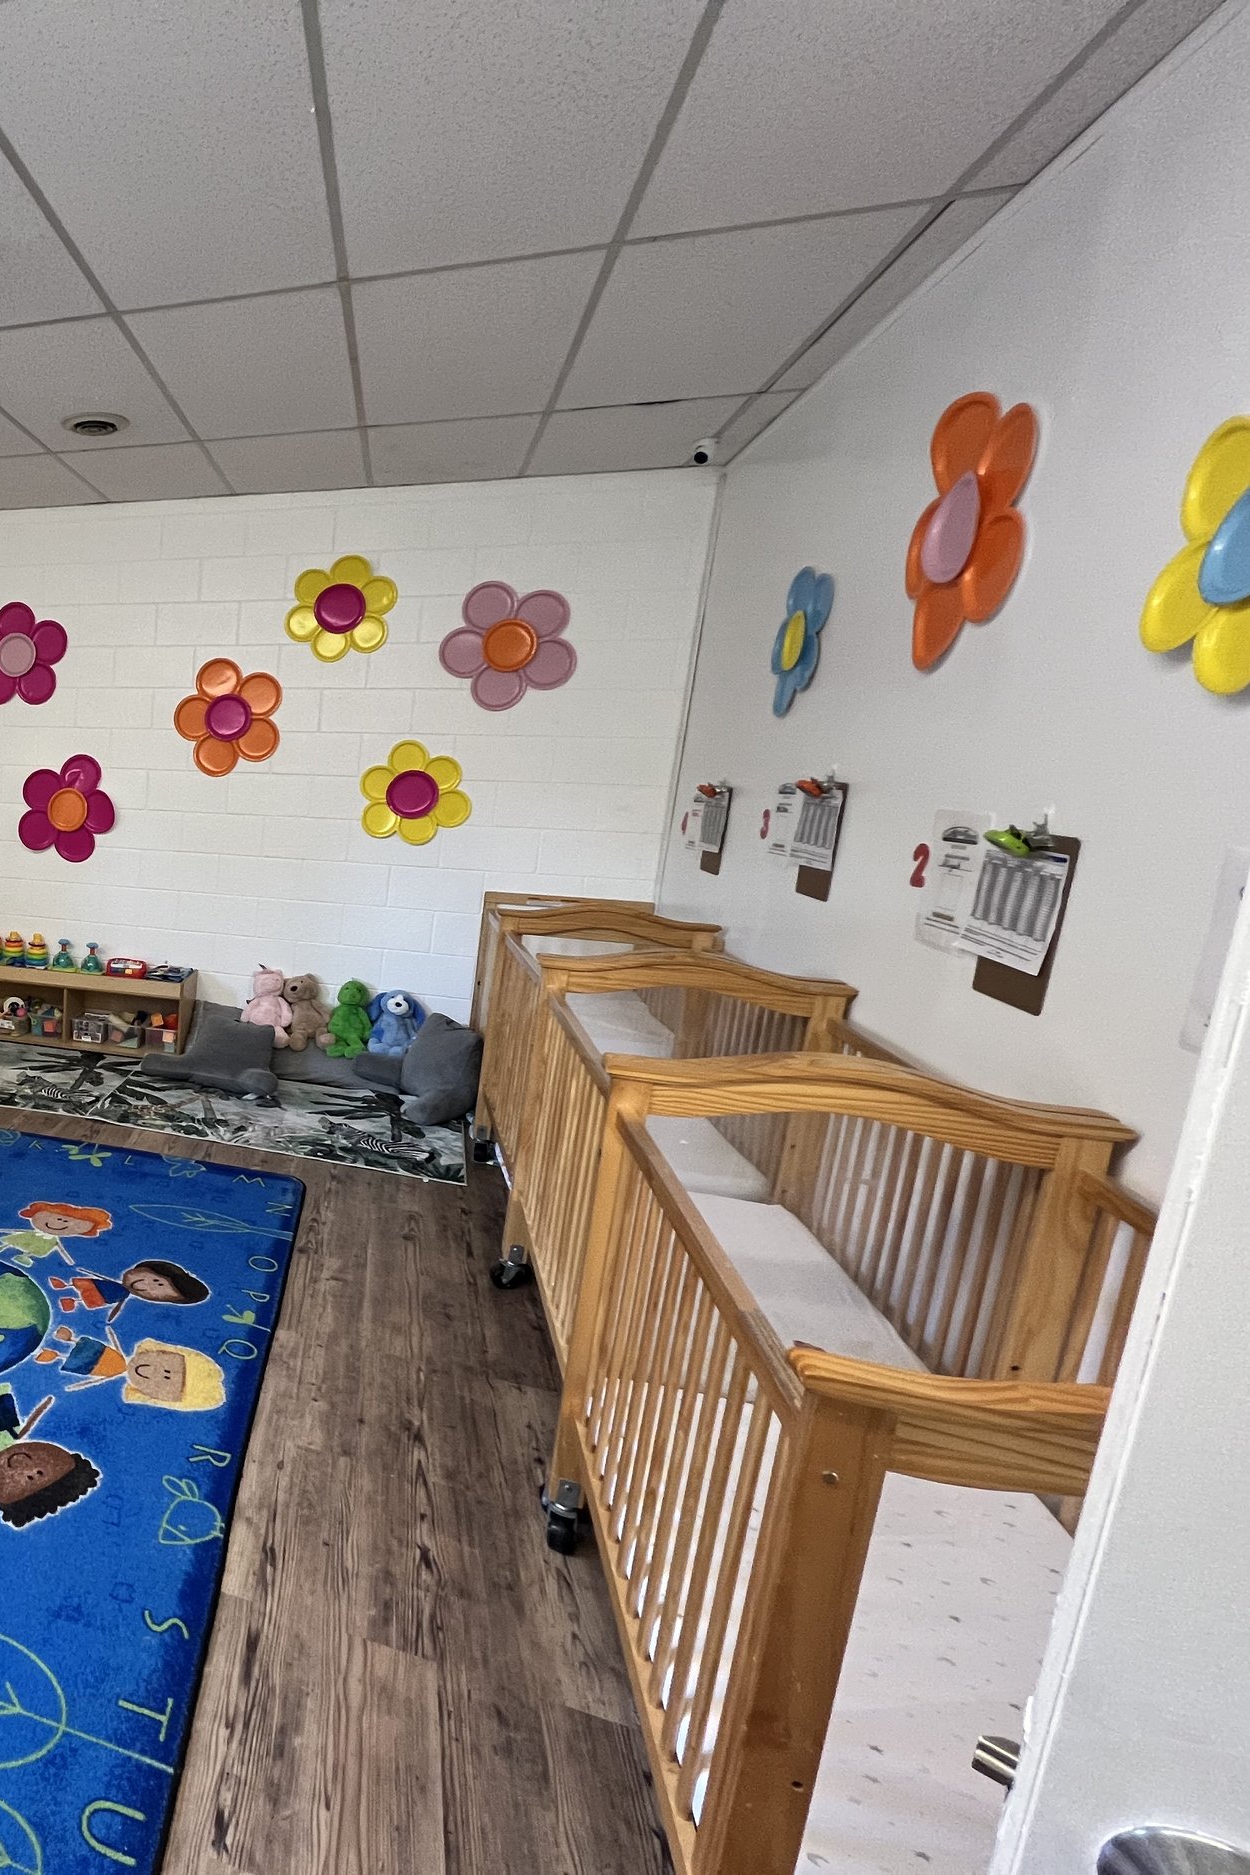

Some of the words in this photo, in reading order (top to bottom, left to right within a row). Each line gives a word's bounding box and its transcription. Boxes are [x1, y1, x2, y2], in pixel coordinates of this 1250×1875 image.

[760, 808, 771, 839] 3
[910, 843, 930, 888] 2
[124, 1155, 134, 1166] L
[232, 1174, 266, 1188] M
[265, 1201, 294, 1217] N
[248, 1255, 278, 1272] O
[241, 1289, 270, 1302] P
[217, 1339, 258, 1359] Q
[188, 1444, 232, 1467] R
[144, 1610, 190, 1639] S
[118, 1697, 173, 1741] T
[81, 1800, 146, 1867] U
